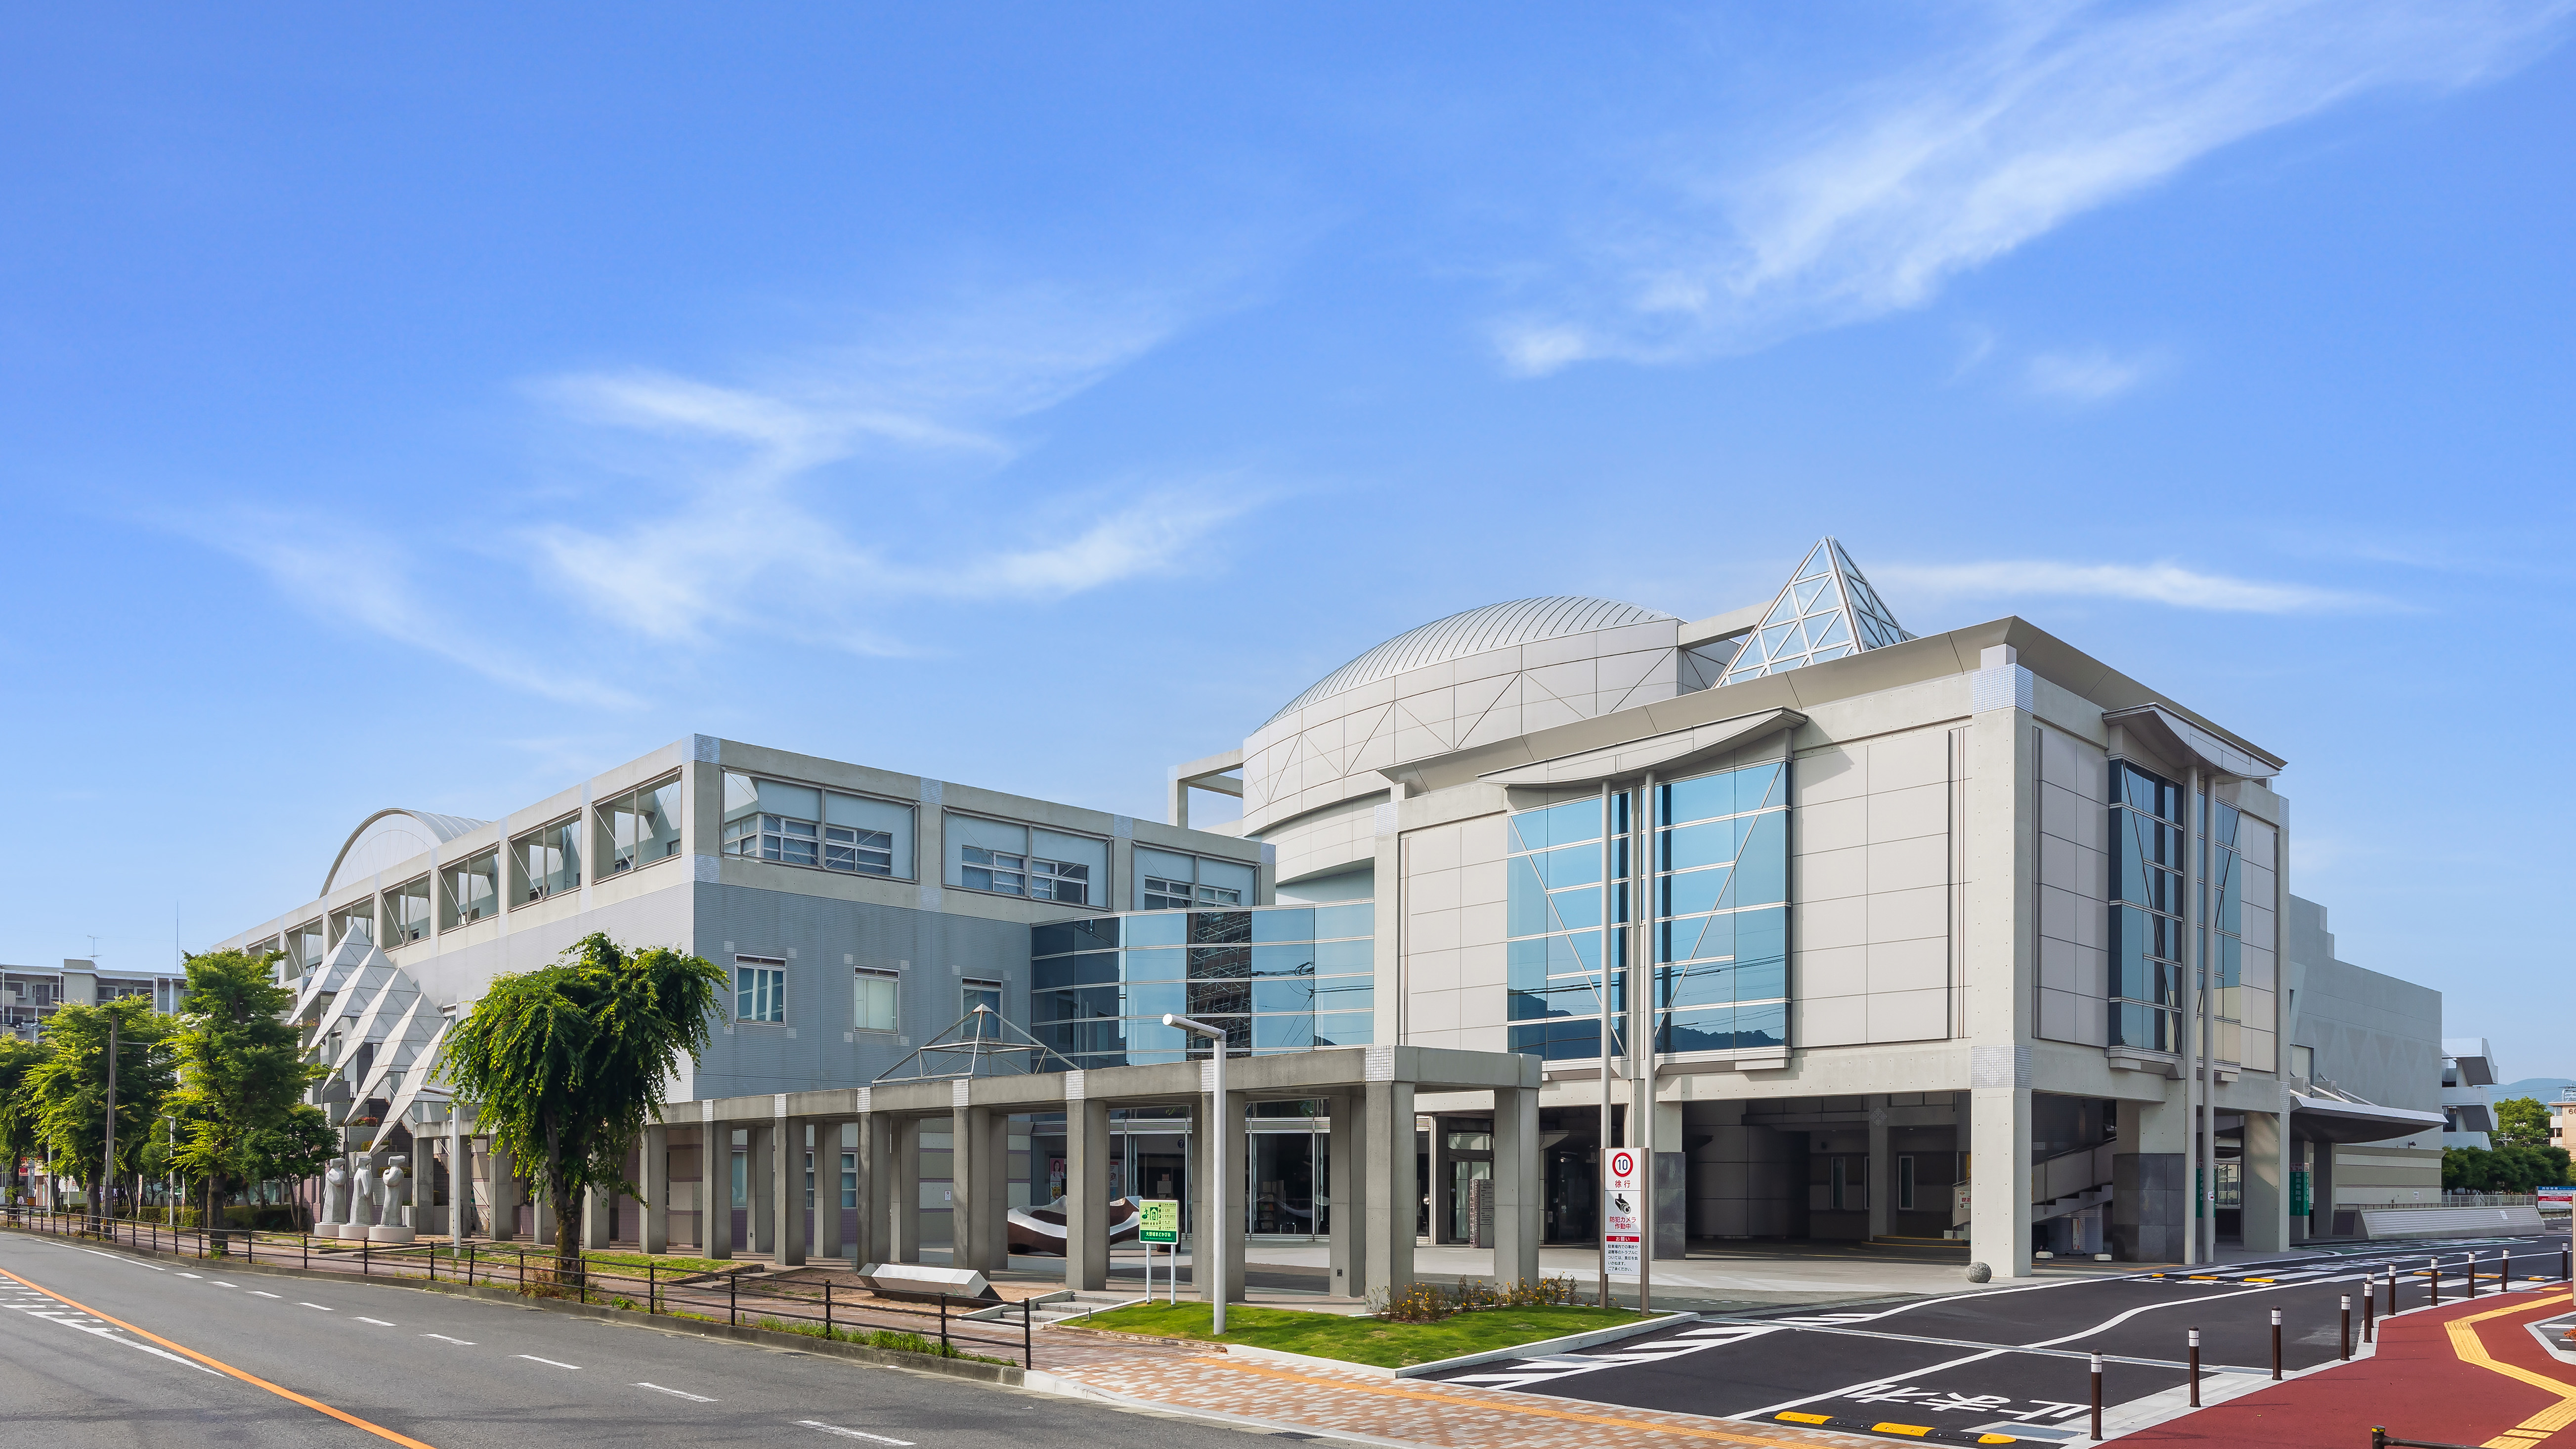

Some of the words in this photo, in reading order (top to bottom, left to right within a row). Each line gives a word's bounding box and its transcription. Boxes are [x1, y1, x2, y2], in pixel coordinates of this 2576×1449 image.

[1618, 1159, 1628, 1170] 10
[1843, 1384, 2106, 1420] 止まれ
